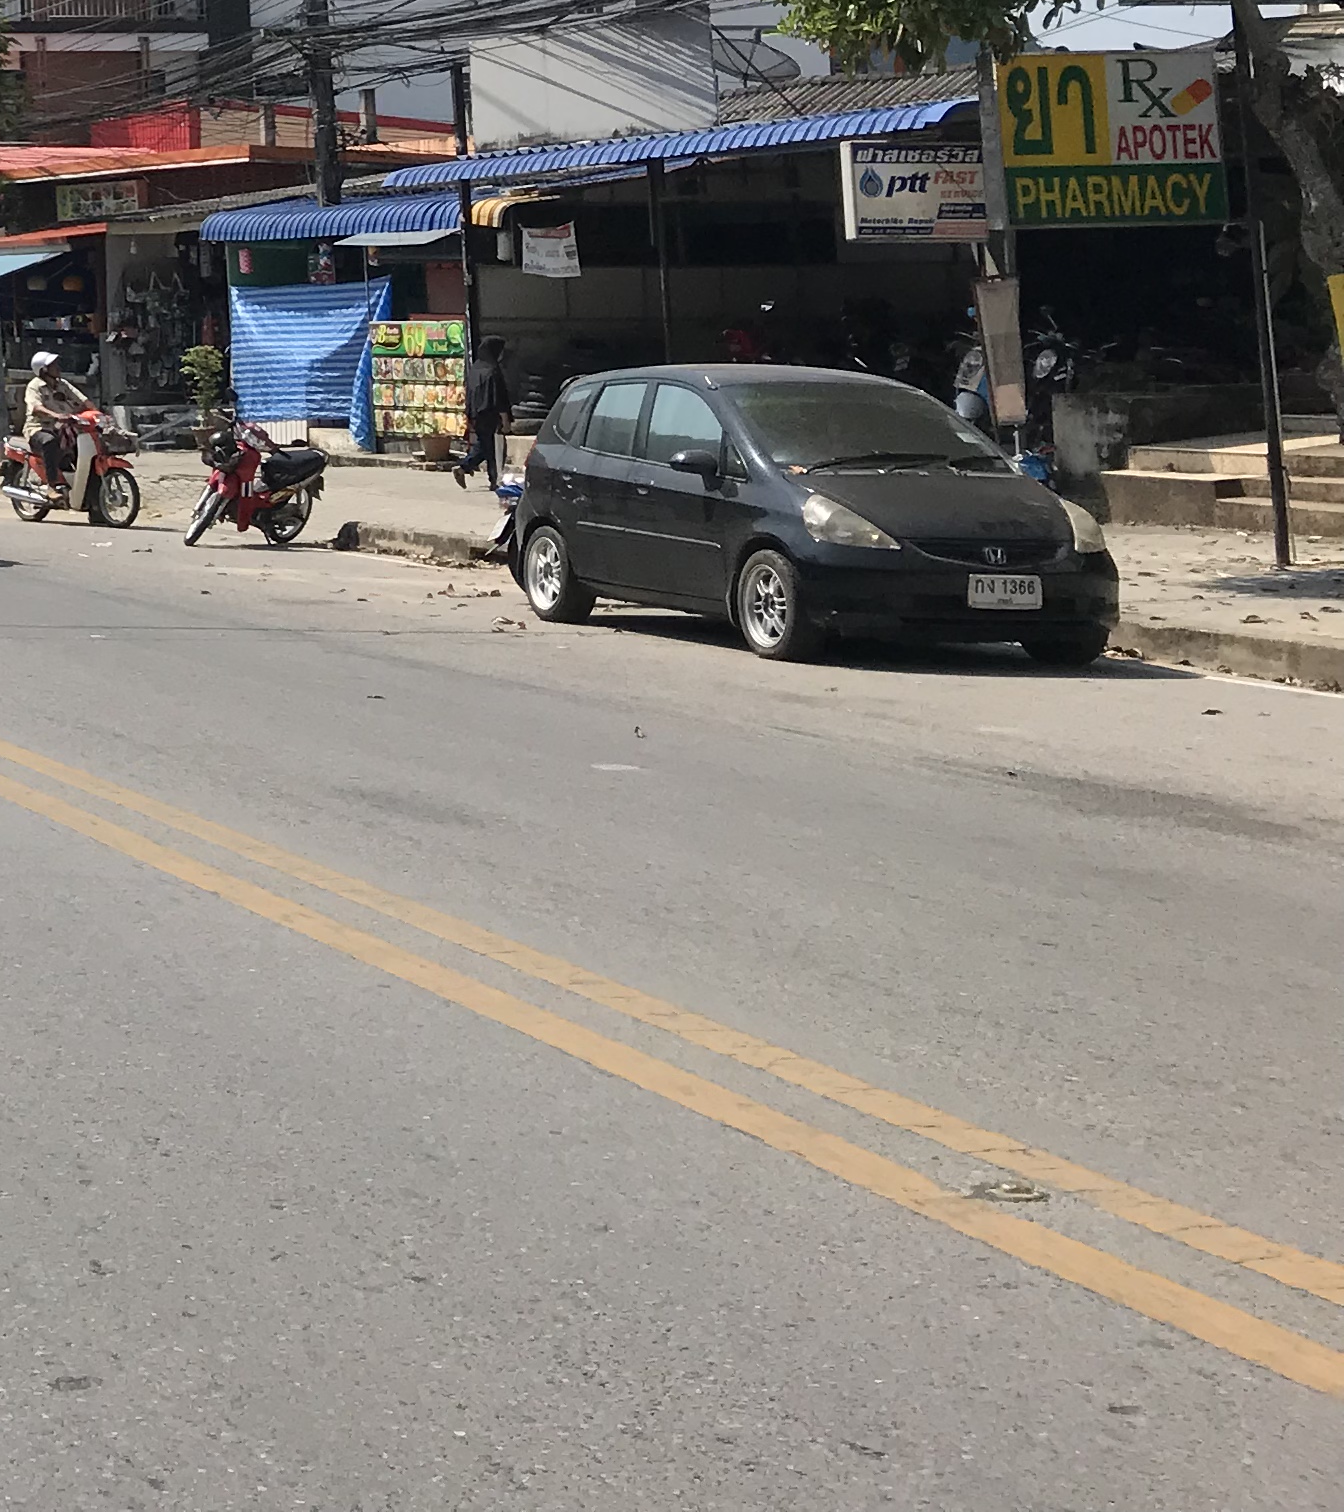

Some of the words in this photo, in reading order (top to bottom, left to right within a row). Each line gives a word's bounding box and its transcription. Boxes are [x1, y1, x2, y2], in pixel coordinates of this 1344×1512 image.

[1007, 65, 1097, 156] ยา
[1116, 123, 1217, 162] APOTEK
[885, 171, 931, 197] ptt
[933, 171, 978, 185] FAST
[1015, 172, 1212, 219] PHARMACY
[1002, 579, 1036, 595] 1366
